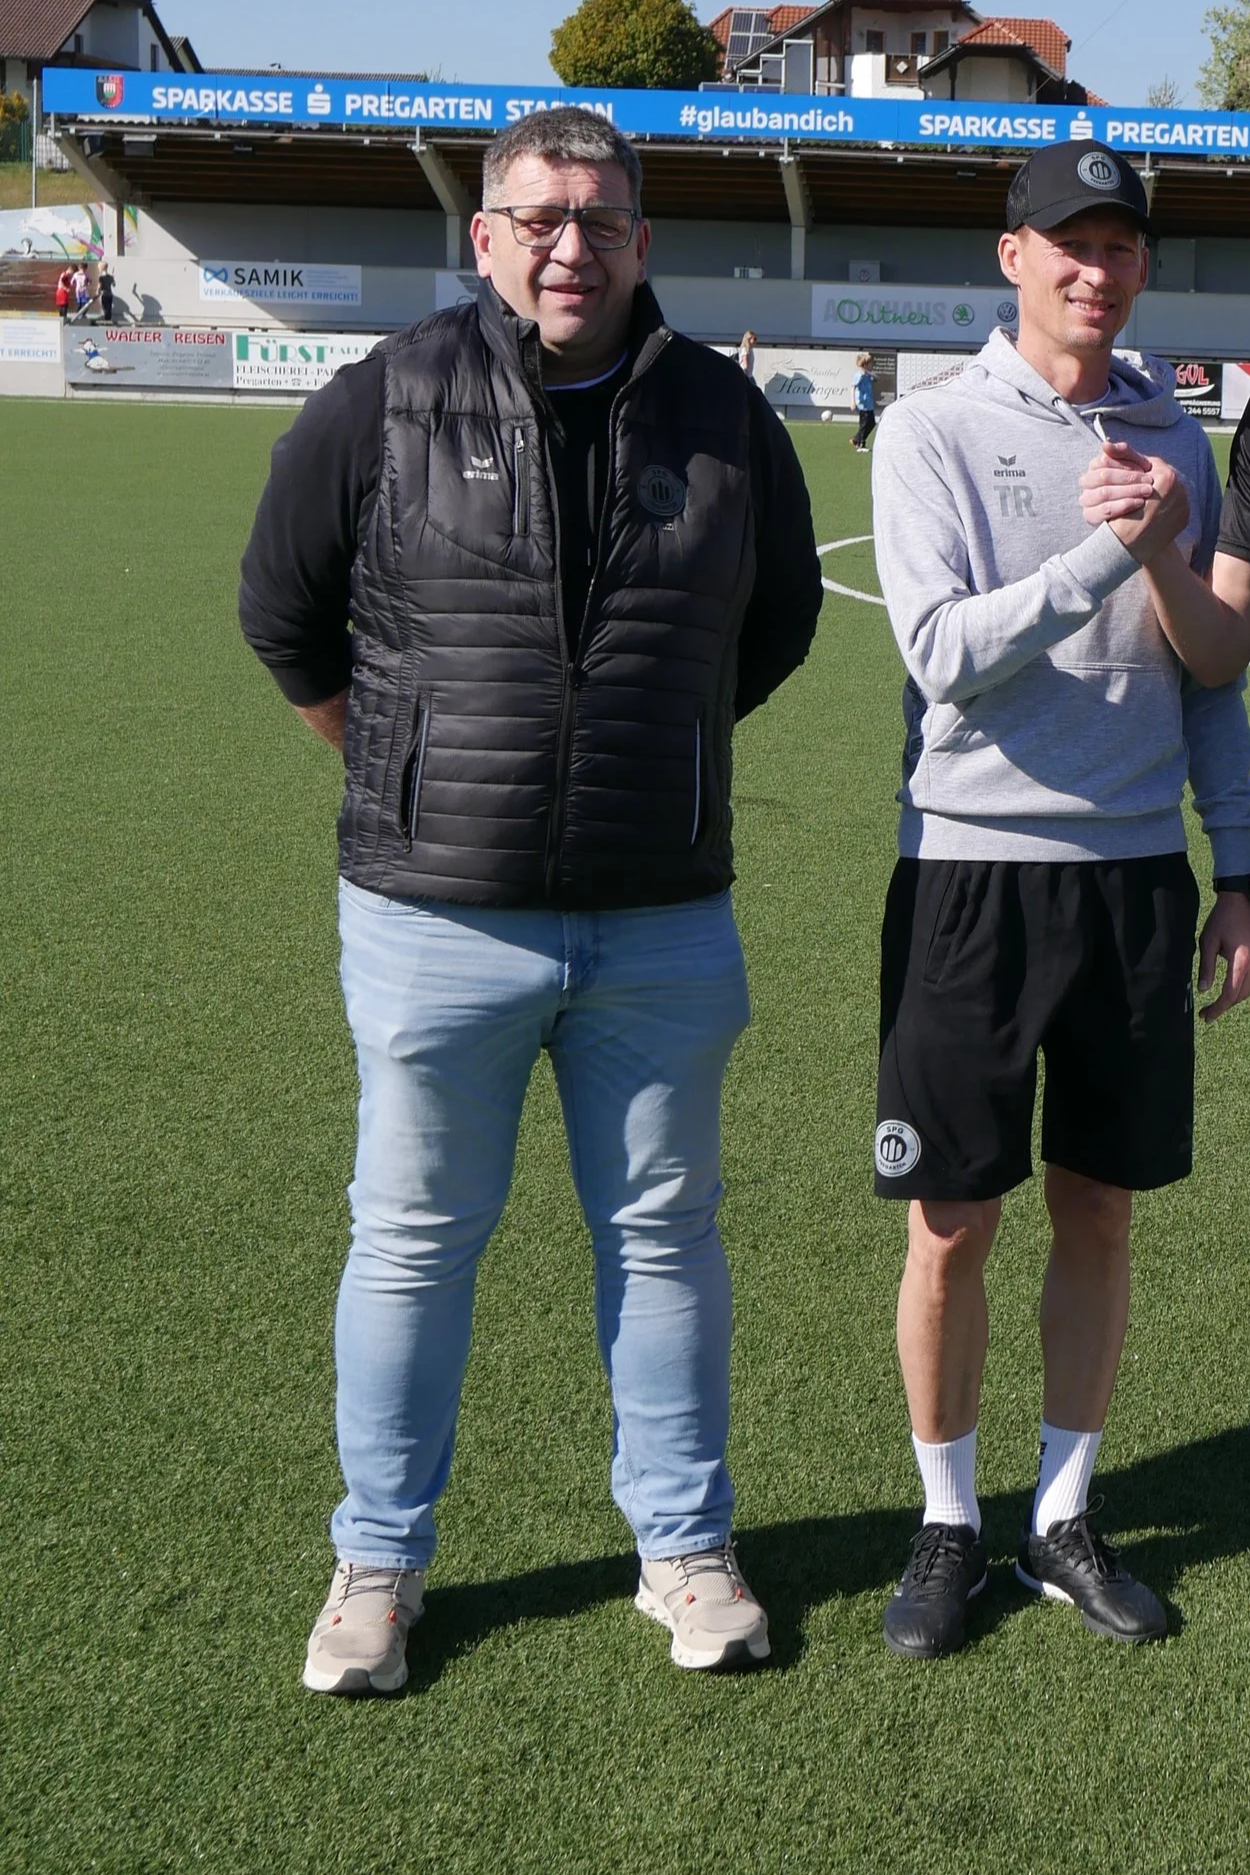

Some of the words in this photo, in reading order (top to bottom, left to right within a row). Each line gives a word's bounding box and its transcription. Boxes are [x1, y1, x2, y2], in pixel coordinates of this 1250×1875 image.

[152, 87, 293, 114] SPARKASSE
[345, 94, 492, 120] PREGARTEN
[680, 106, 854, 133] #glaubandich
[919, 114, 1056, 140] SPARKASSE
[1106, 122, 1249, 148] PREGARTEN
[234, 267, 304, 287] SAMIK
[203, 288, 275, 299] VERKAUFSZIELE
[277, 290, 309, 300] LEICHT
[311, 291, 358, 302] ERREICHT!
[836, 298, 933, 325] Ortner
[106, 330, 162, 343] WALTER
[174, 332, 226, 345] REISEN
[8, 348, 57, 359] ERREICHT!
[236, 365, 309, 376] FLEISCHEREI
[236, 375, 282, 387] Pregarten
[775, 377, 849, 400] Haslinger
[463, 470, 499, 482] erima
[993, 468, 1027, 478] erima
[993, 484, 1037, 518] TR
[887, 1126, 904, 1134] SPG
